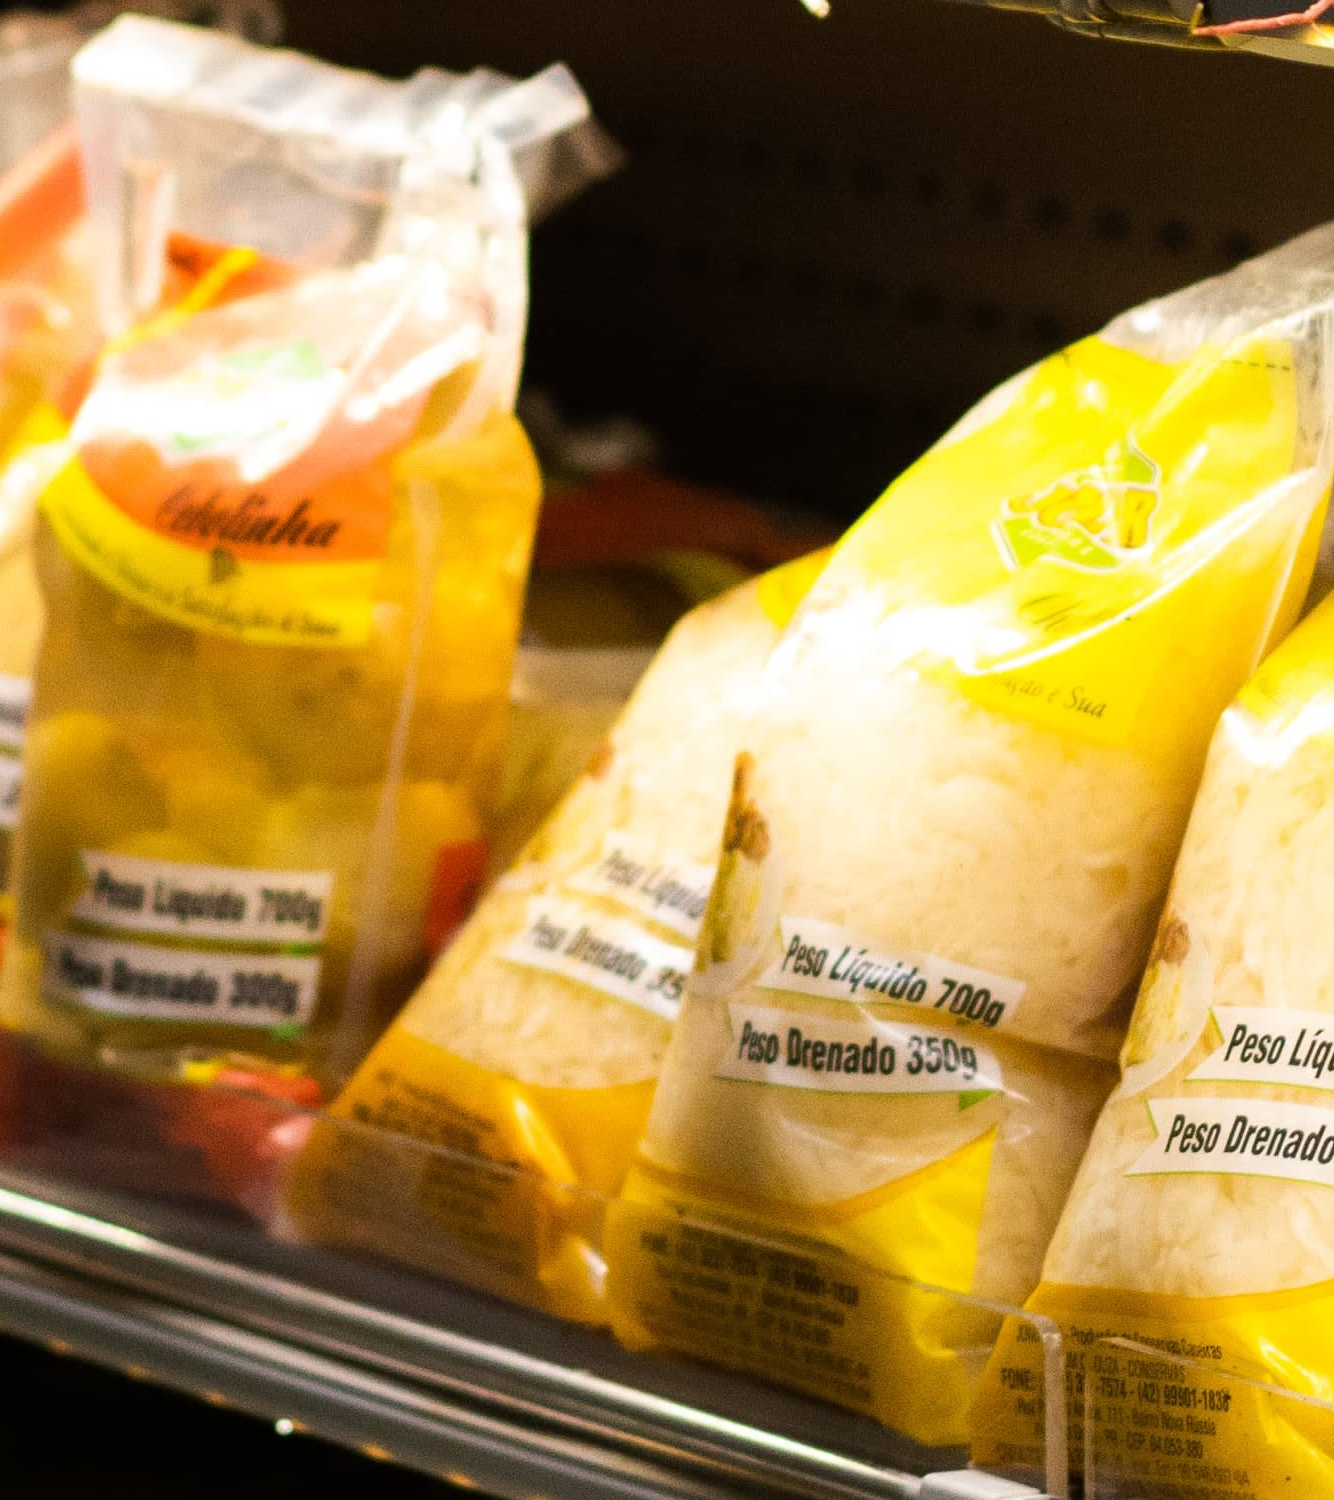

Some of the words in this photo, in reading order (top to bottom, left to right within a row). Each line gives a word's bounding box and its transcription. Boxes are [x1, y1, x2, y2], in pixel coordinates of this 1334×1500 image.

[1064, 685, 1108, 720] Sua
[781, 934, 829, 978] Peso
[828, 945, 928, 1003] Líquido
[933, 977, 1006, 1028] 700g
[739, 1020, 780, 1065] Peso
[786, 1027, 897, 1077] Drenado
[906, 1034, 978, 1082] 350g
[1224, 1022, 1286, 1066] Peso
[1165, 1113, 1222, 1154] Peso
